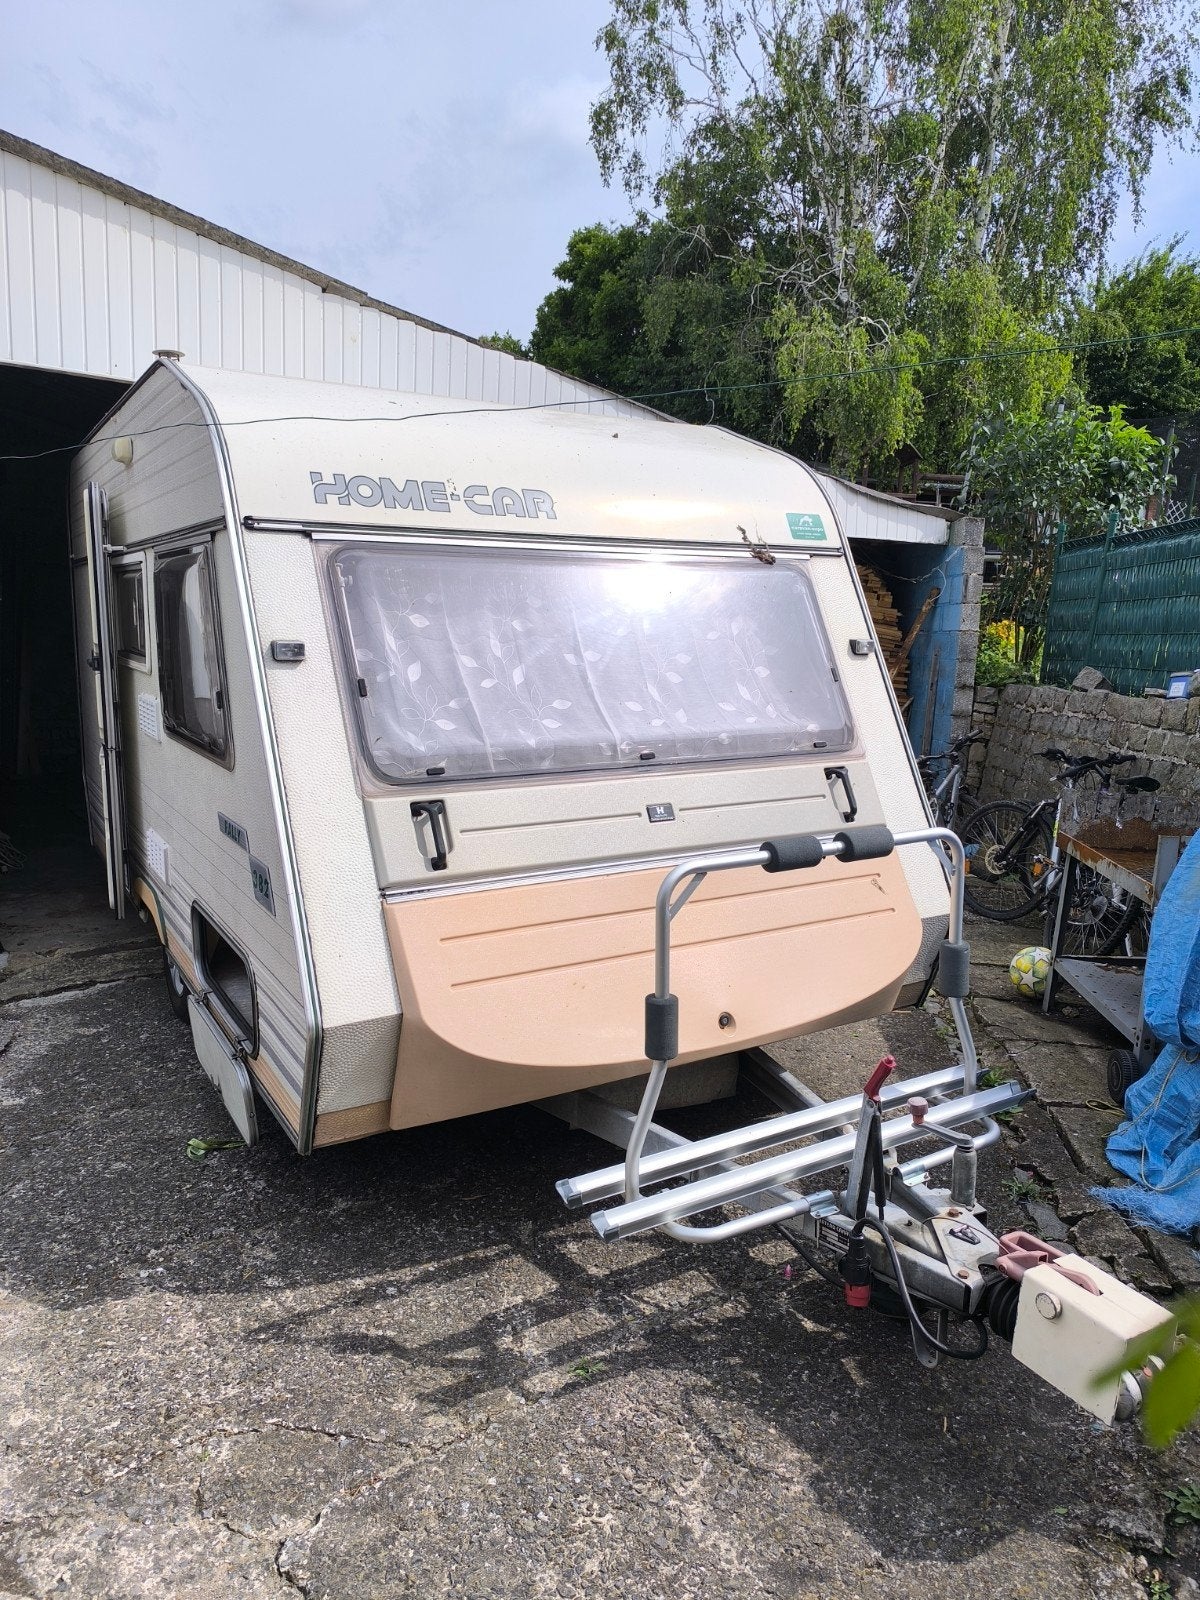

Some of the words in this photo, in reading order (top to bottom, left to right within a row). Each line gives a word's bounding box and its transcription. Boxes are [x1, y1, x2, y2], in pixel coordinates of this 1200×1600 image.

[309, 471, 557, 519] HOME-CAR
[656, 806, 665, 814] H
[252, 870, 269, 898] 382
